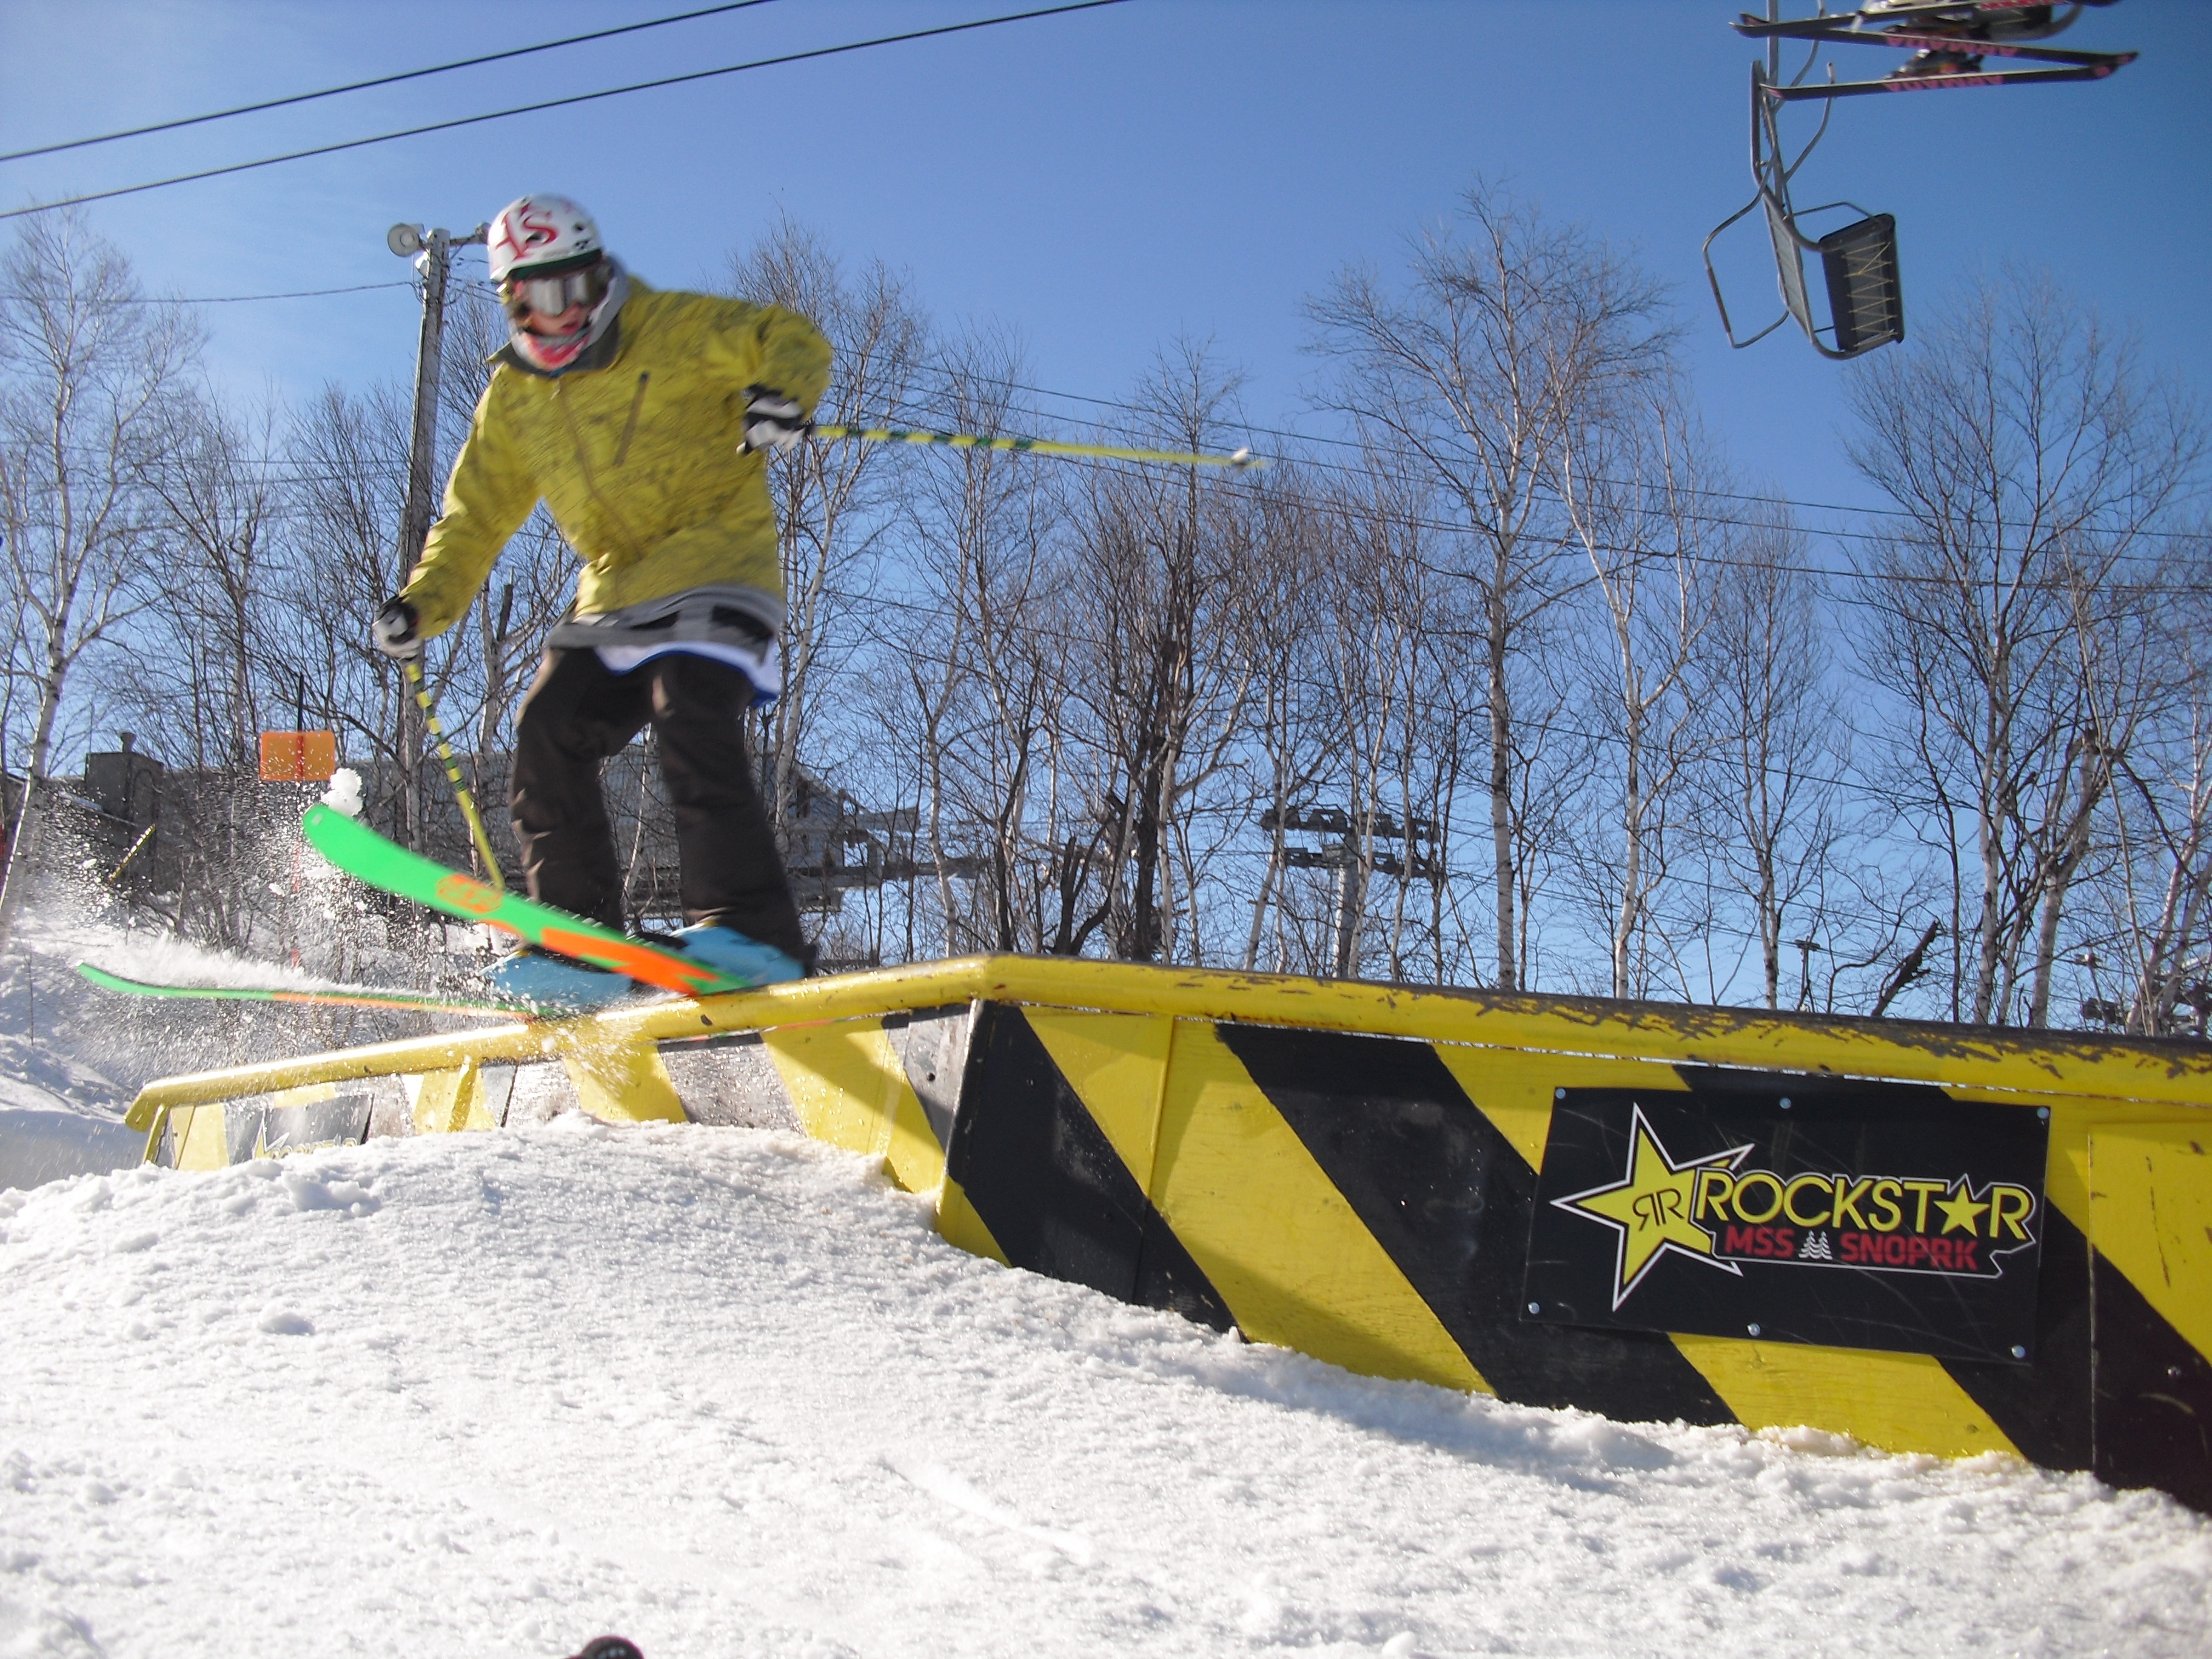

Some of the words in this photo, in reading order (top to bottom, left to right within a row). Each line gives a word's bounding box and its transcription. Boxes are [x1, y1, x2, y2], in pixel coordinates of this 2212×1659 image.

[1697, 1171, 2030, 1240] ROCKSTAR
[1725, 1225, 1795, 1256] MSS
[1840, 1232, 1978, 1270] SNOPRK
